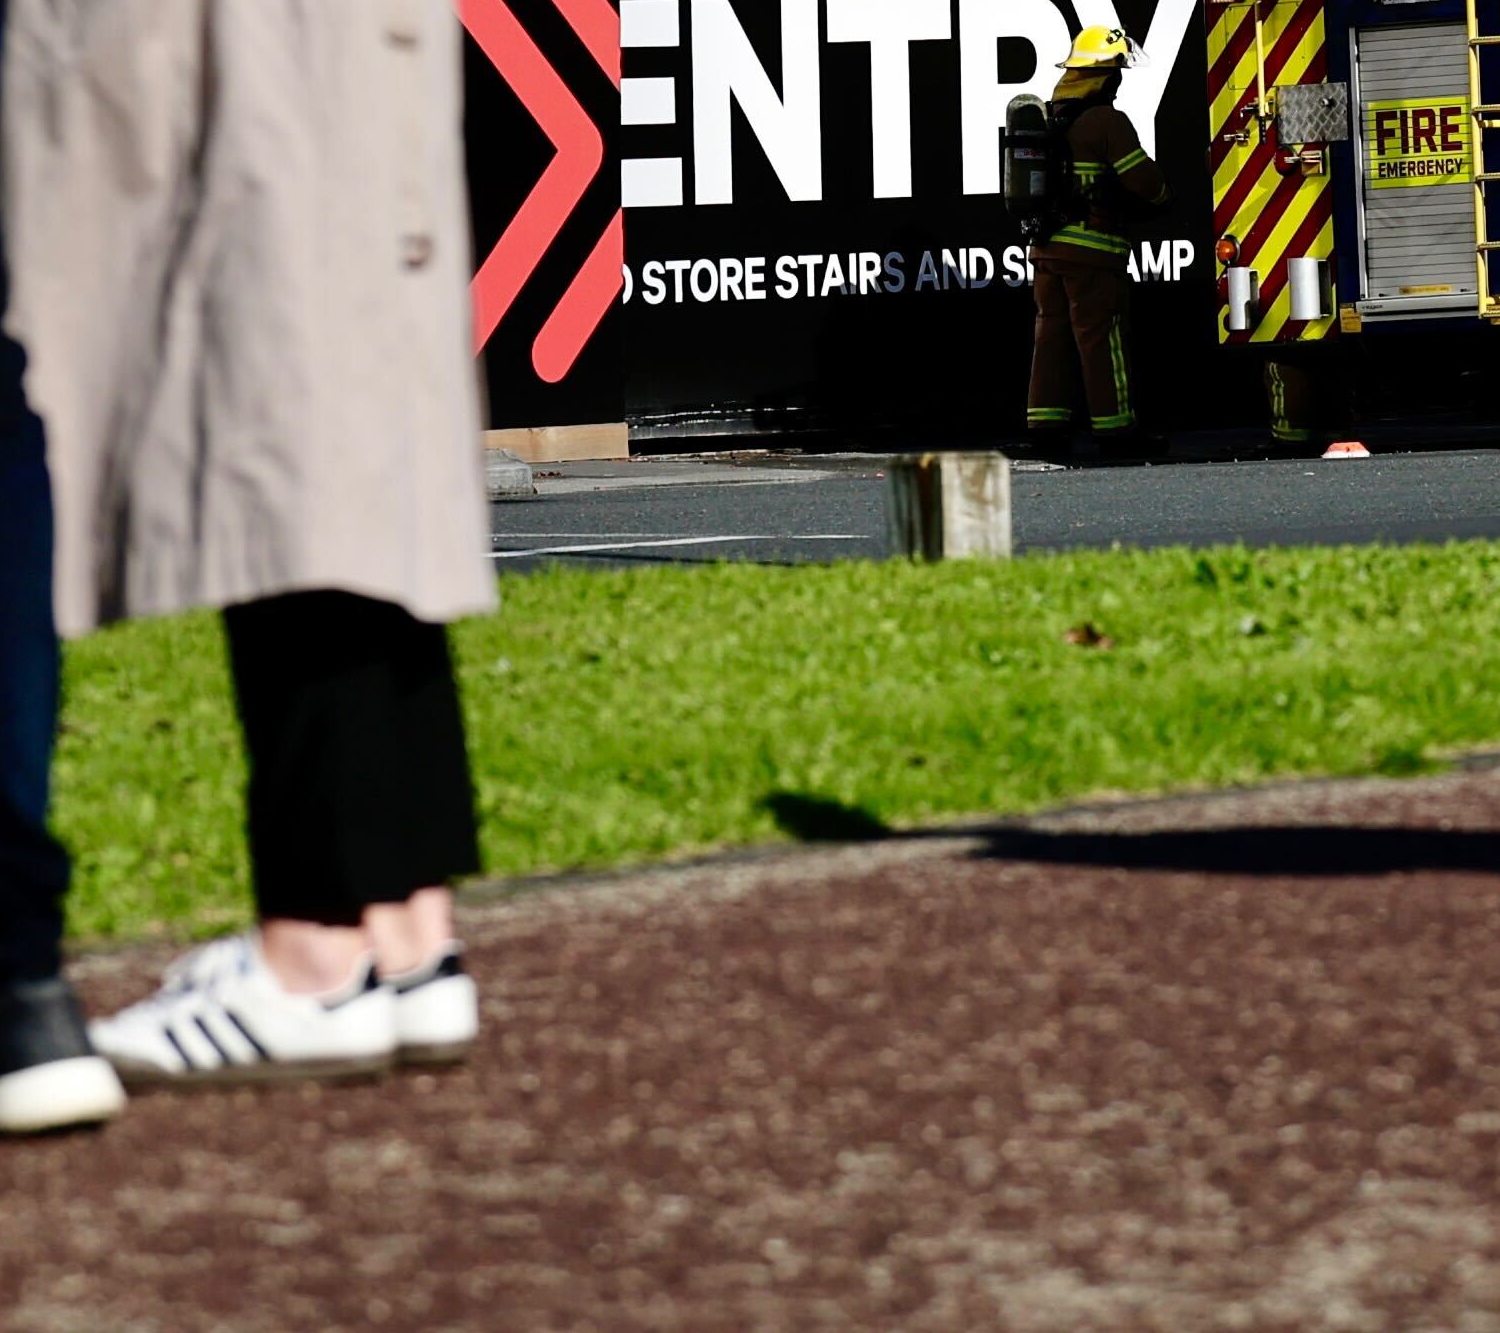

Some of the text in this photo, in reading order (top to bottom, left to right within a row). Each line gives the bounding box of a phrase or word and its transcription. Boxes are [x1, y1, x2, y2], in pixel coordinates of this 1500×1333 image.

[1375, 106, 1463, 156] FIRE
[1378, 158, 1464, 179] EMERGENCY
[642, 256, 766, 305] STORE
[775, 251, 906, 300] STAIRS
[914, 247, 995, 292] AND
[1125, 239, 1195, 282] AMP
